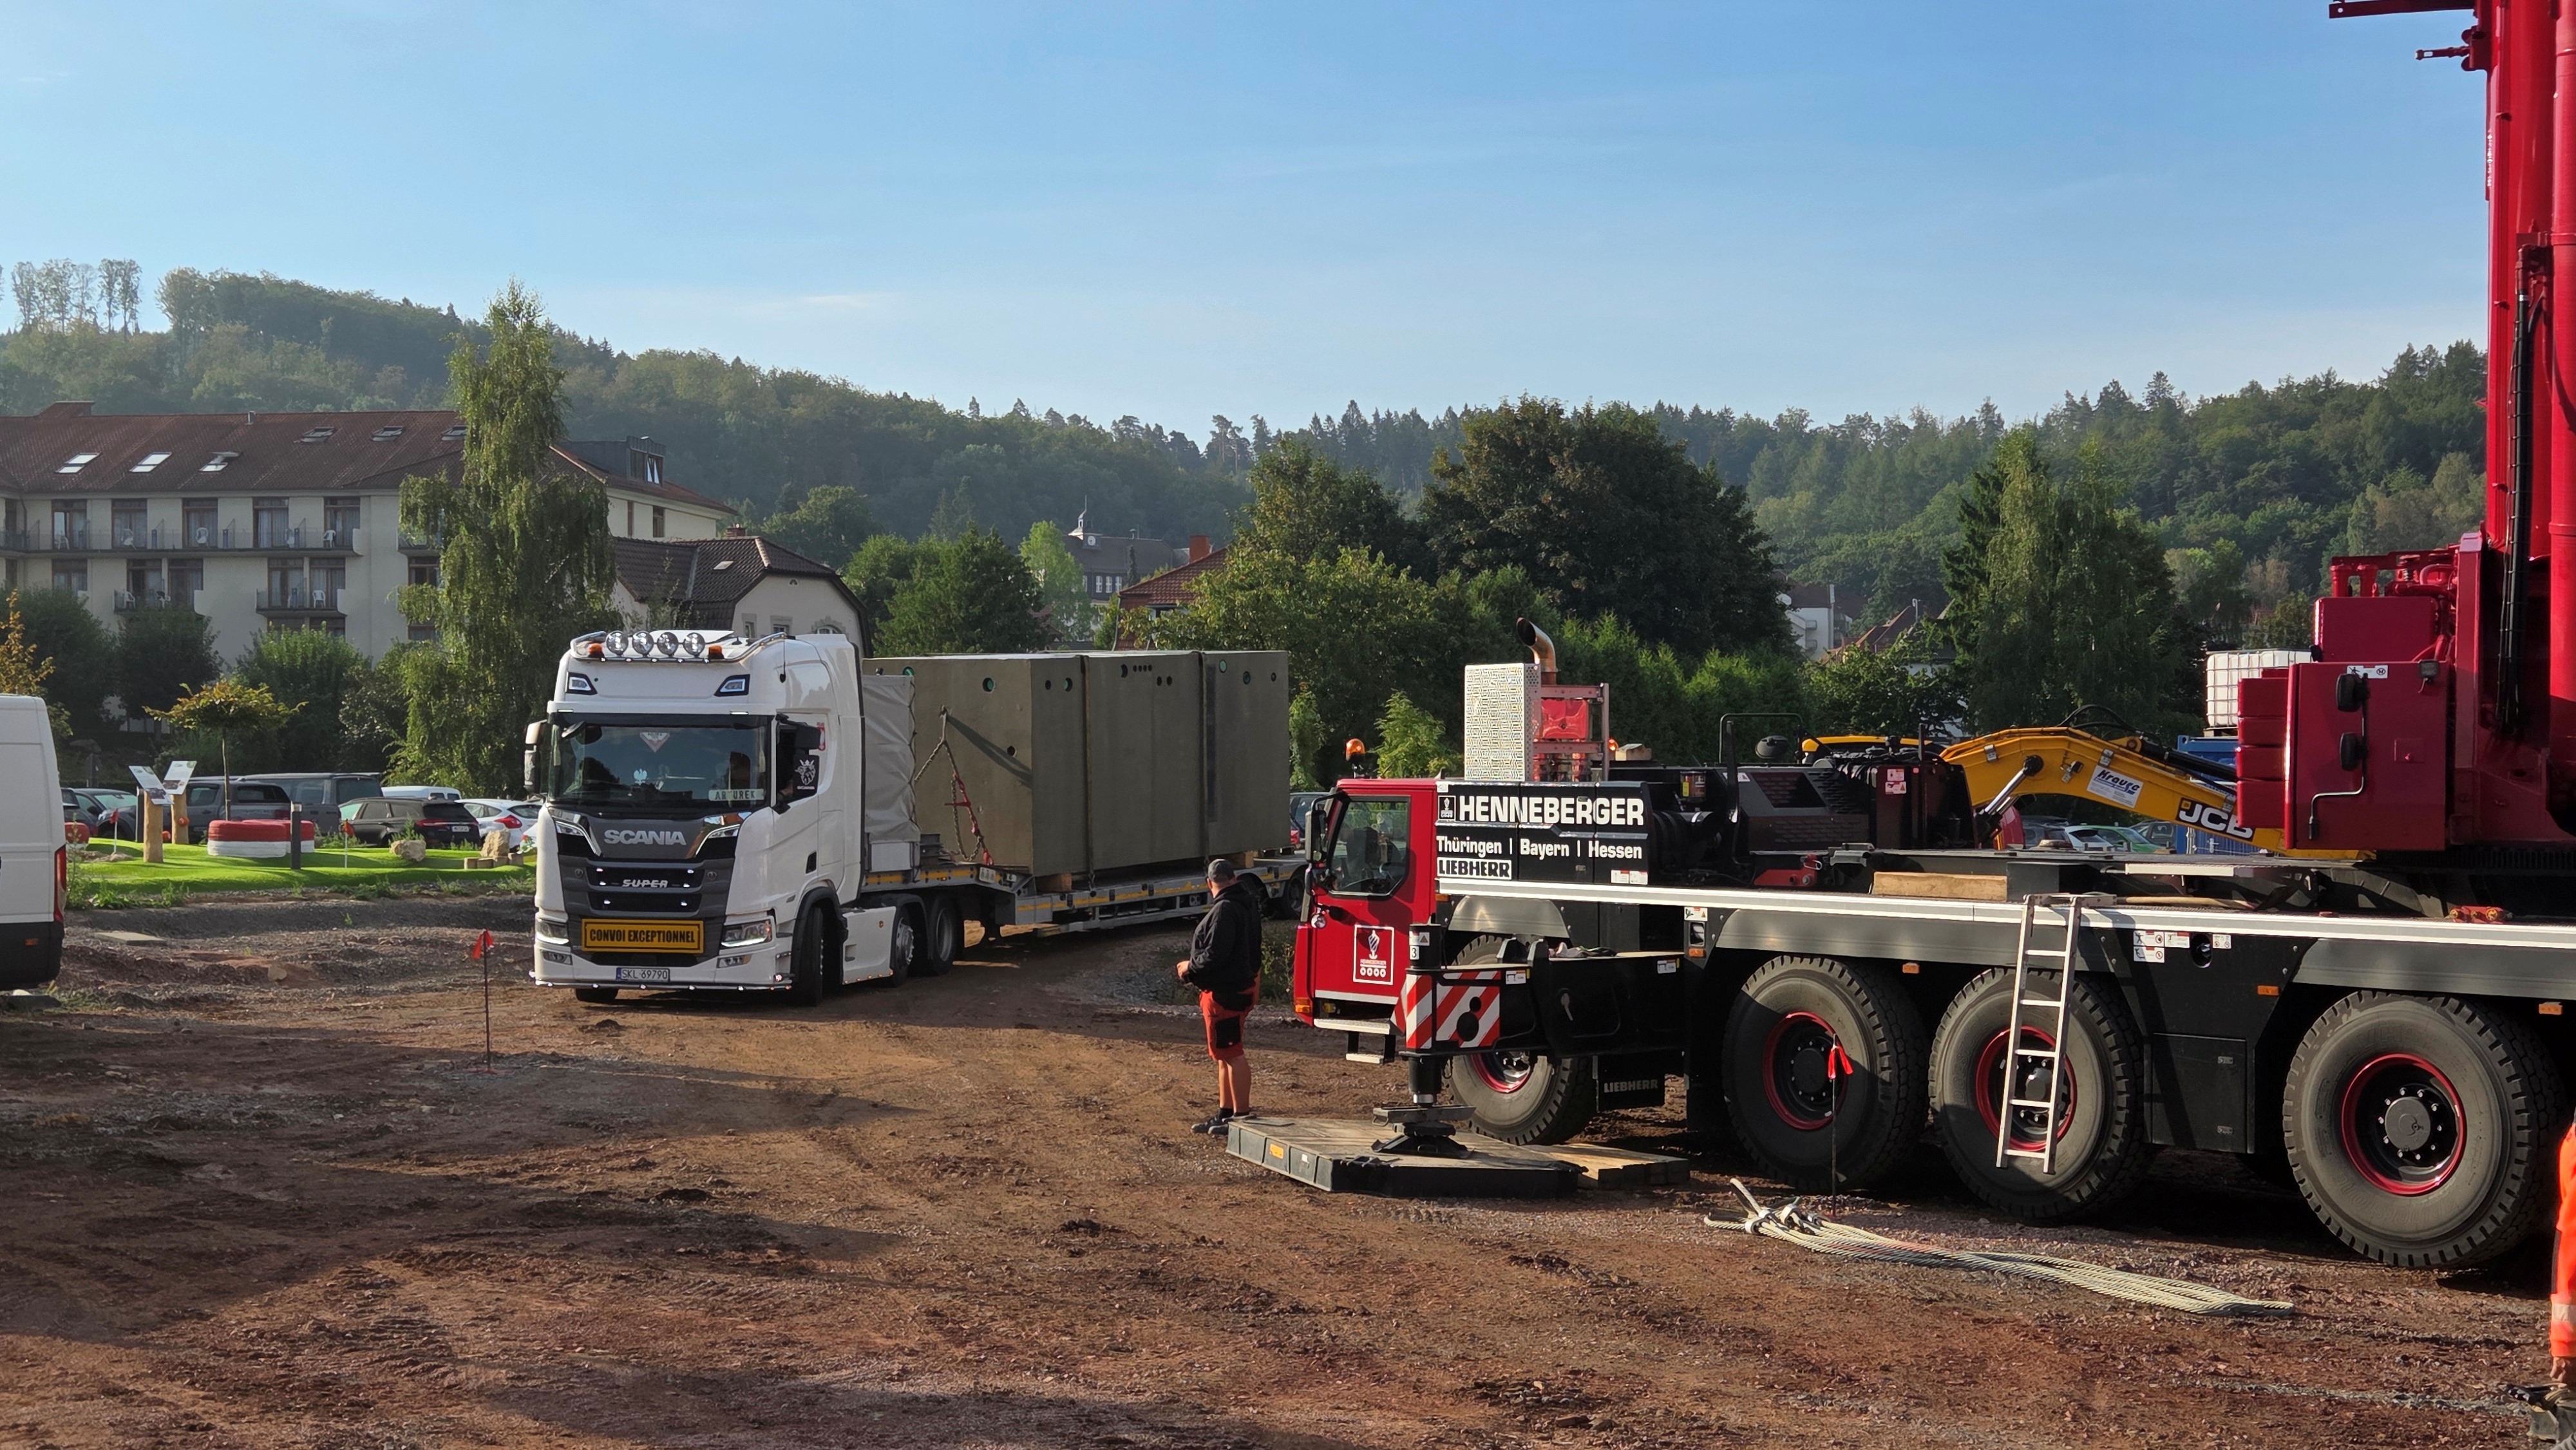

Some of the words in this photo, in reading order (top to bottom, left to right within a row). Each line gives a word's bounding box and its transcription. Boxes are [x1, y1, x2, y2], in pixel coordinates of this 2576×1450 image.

[2098, 769, 2140, 792] Krause
[1459, 796, 1644, 825] HENNEBERGER
[604, 829, 687, 845] SCANIA
[1436, 836, 1502, 858] Thüringen
[1520, 838, 1569, 860] Bayern
[1588, 840, 1642, 859] Hessen
[1439, 860, 1510, 878] LIEBHERR
[622, 879, 668, 889] SUPER
[590, 929, 625, 942] CONVOI
[628, 930, 696, 943] EXCEPTIONNEL
[1411, 947, 1417, 958] 3
[622, 970, 638, 979] SKL
[641, 970, 668, 979] 69790
[1604, 1079, 1658, 1093] LIEBHERR
